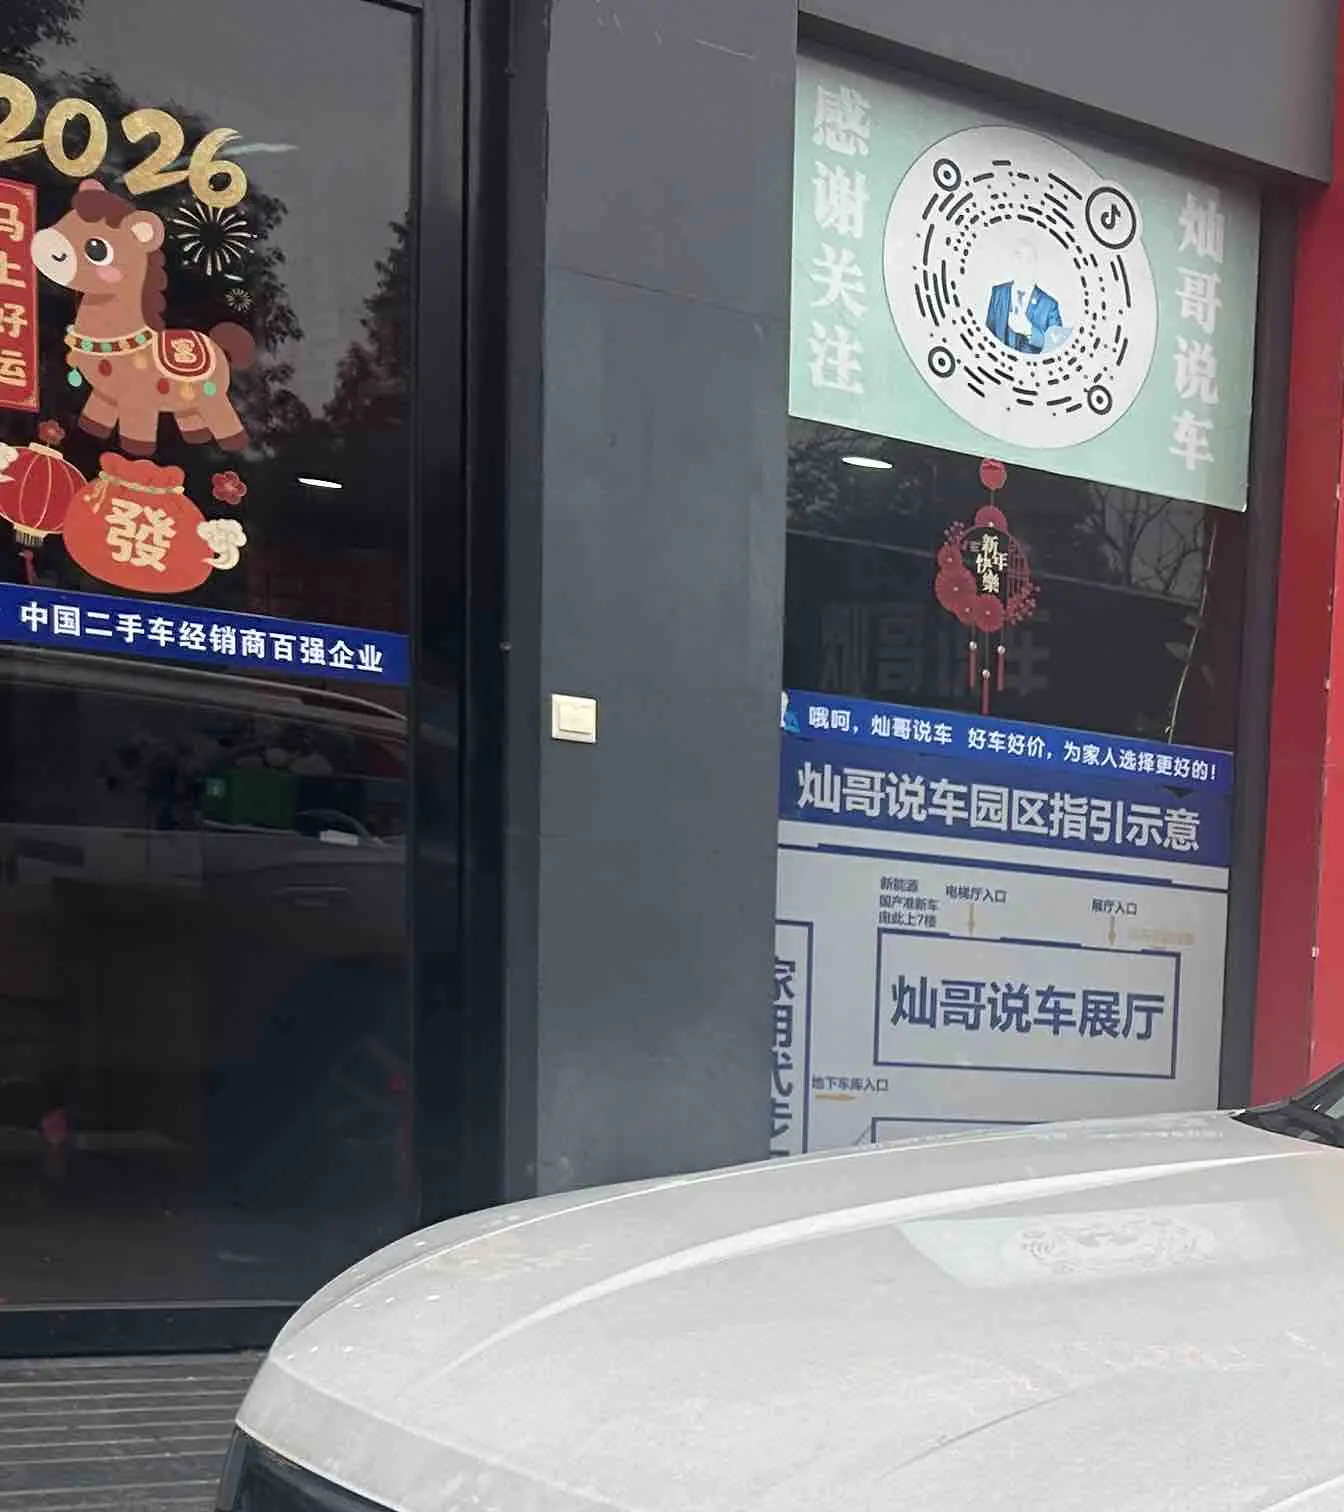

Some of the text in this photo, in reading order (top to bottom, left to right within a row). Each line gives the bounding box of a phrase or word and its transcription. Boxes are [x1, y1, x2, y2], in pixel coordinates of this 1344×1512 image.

[0, 73, 248, 208] 2026
[808, 85, 871, 394] 感谢关注
[1170, 192, 1225, 471] 灿哥说车
[105, 497, 177, 573] 發
[20, 601, 384, 674] 中国二手车经销商百强企业
[797, 761, 1200, 852] 灿哥说车园区指引示意
[945, 884, 1008, 904] 电梯厅入口
[890, 975, 1165, 1040] 灿哥说车展厅
[811, 1076, 889, 1092] 地下车库入口
